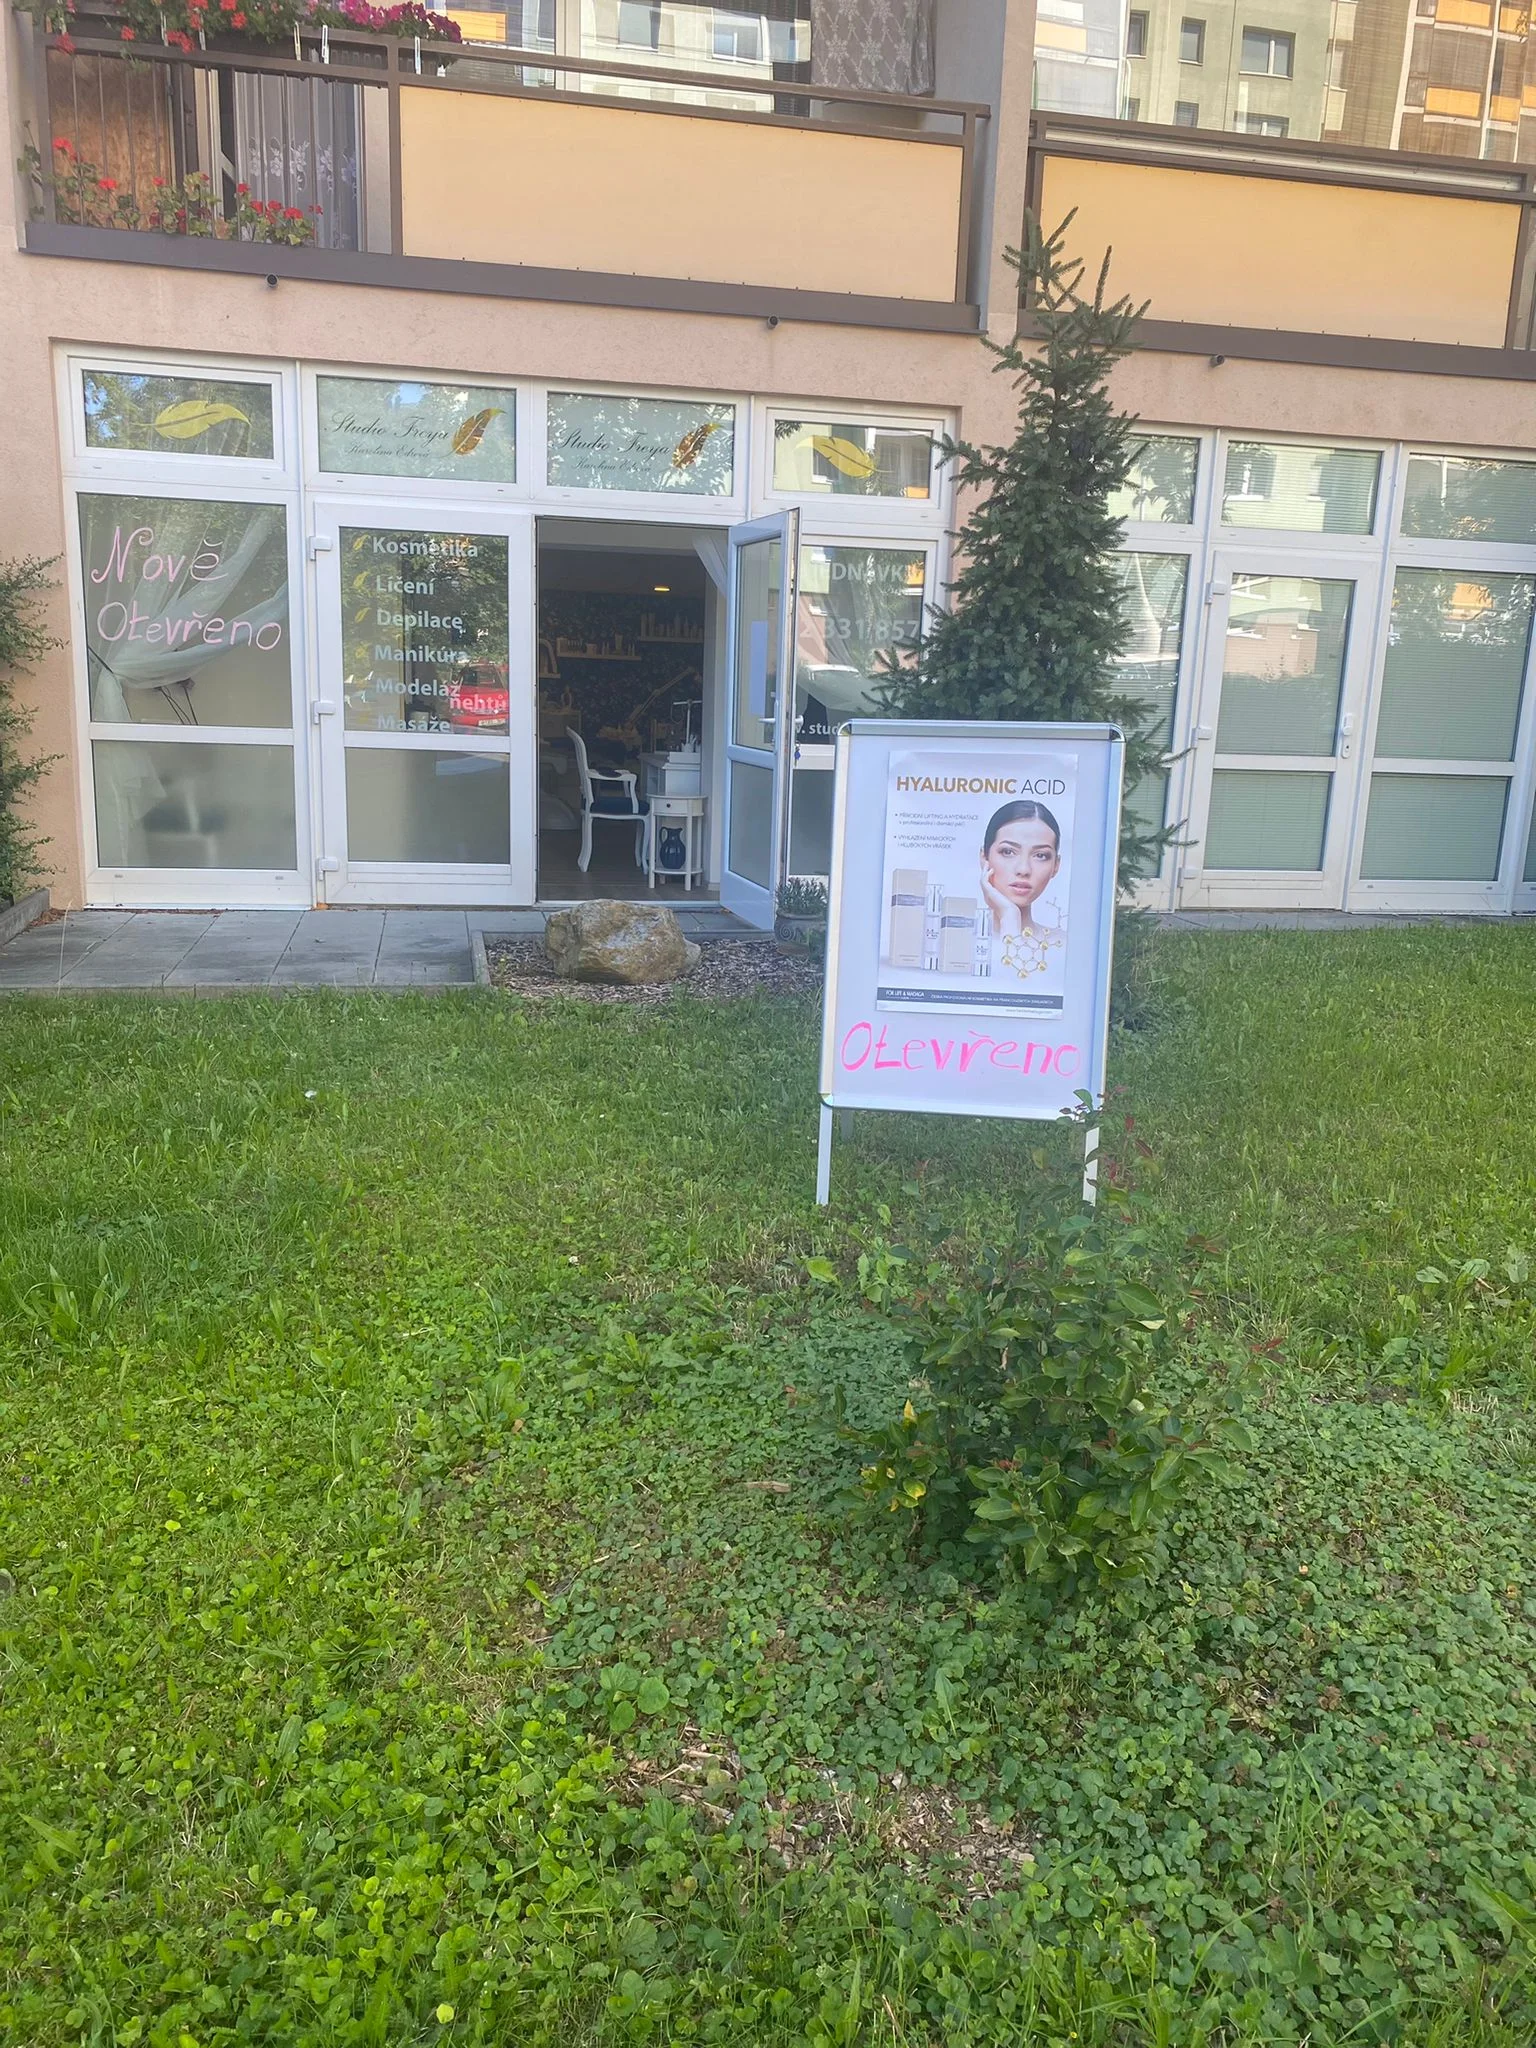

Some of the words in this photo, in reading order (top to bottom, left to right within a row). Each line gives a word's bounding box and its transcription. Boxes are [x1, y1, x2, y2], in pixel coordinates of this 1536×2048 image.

[324, 410, 387, 434] Studio
[553, 427, 610, 451] Studio
[372, 536, 479, 558] Kosmetika
[376, 574, 435, 596] Líčení
[97, 600, 282, 651] Otevřeno
[376, 607, 464, 632] Depilace
[374, 644, 469, 664] Manikúra
[375, 677, 461, 698] Modeláž
[377, 715, 450, 733] Masáže
[896, 776, 1018, 795] HYALURONIC
[1020, 778, 1066, 796] ACID
[841, 1021, 1082, 1077] Otevřeno
